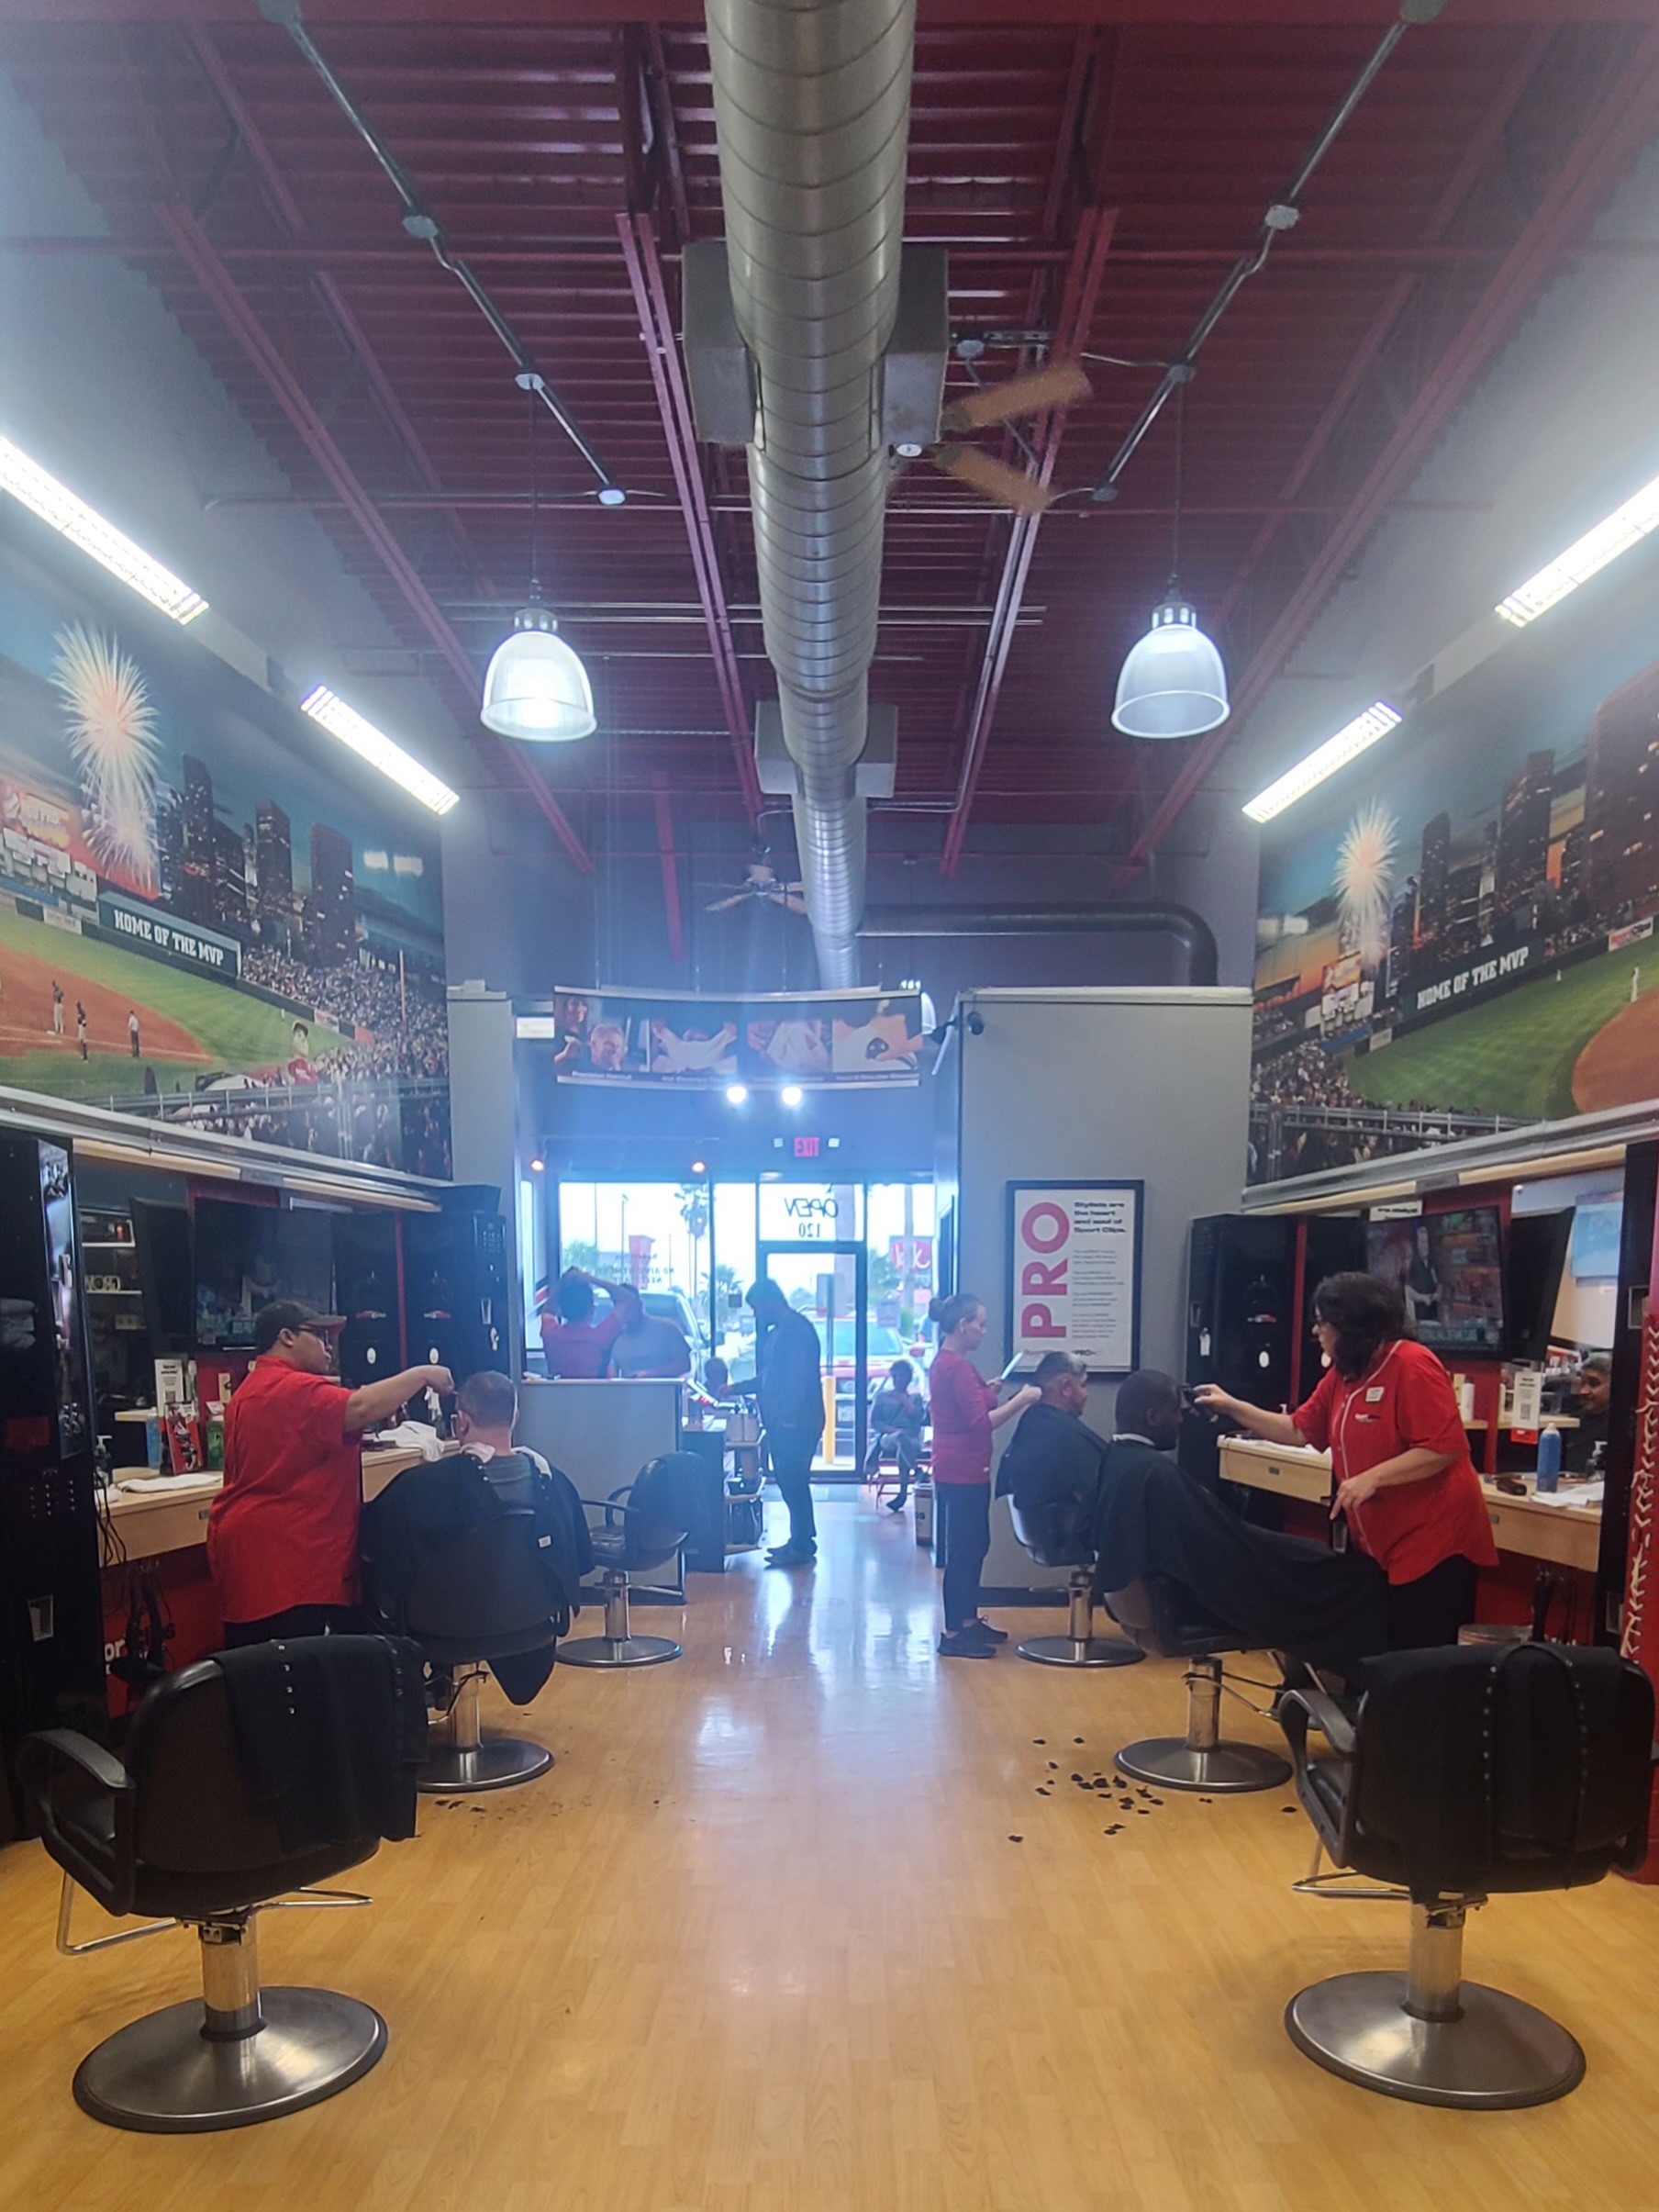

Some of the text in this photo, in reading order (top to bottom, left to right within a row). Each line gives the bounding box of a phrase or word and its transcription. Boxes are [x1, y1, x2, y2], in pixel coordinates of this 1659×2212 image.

[114, 910, 152, 941] HOME
[154, 924, 170, 946] OF
[173, 932, 196, 956] THE
[198, 941, 224, 966] MVP
[1417, 945, 1529, 1010] HOME OF THE MVP
[794, 1136, 820, 1157] EXIT
[1020, 1201, 1070, 1338] PRO
